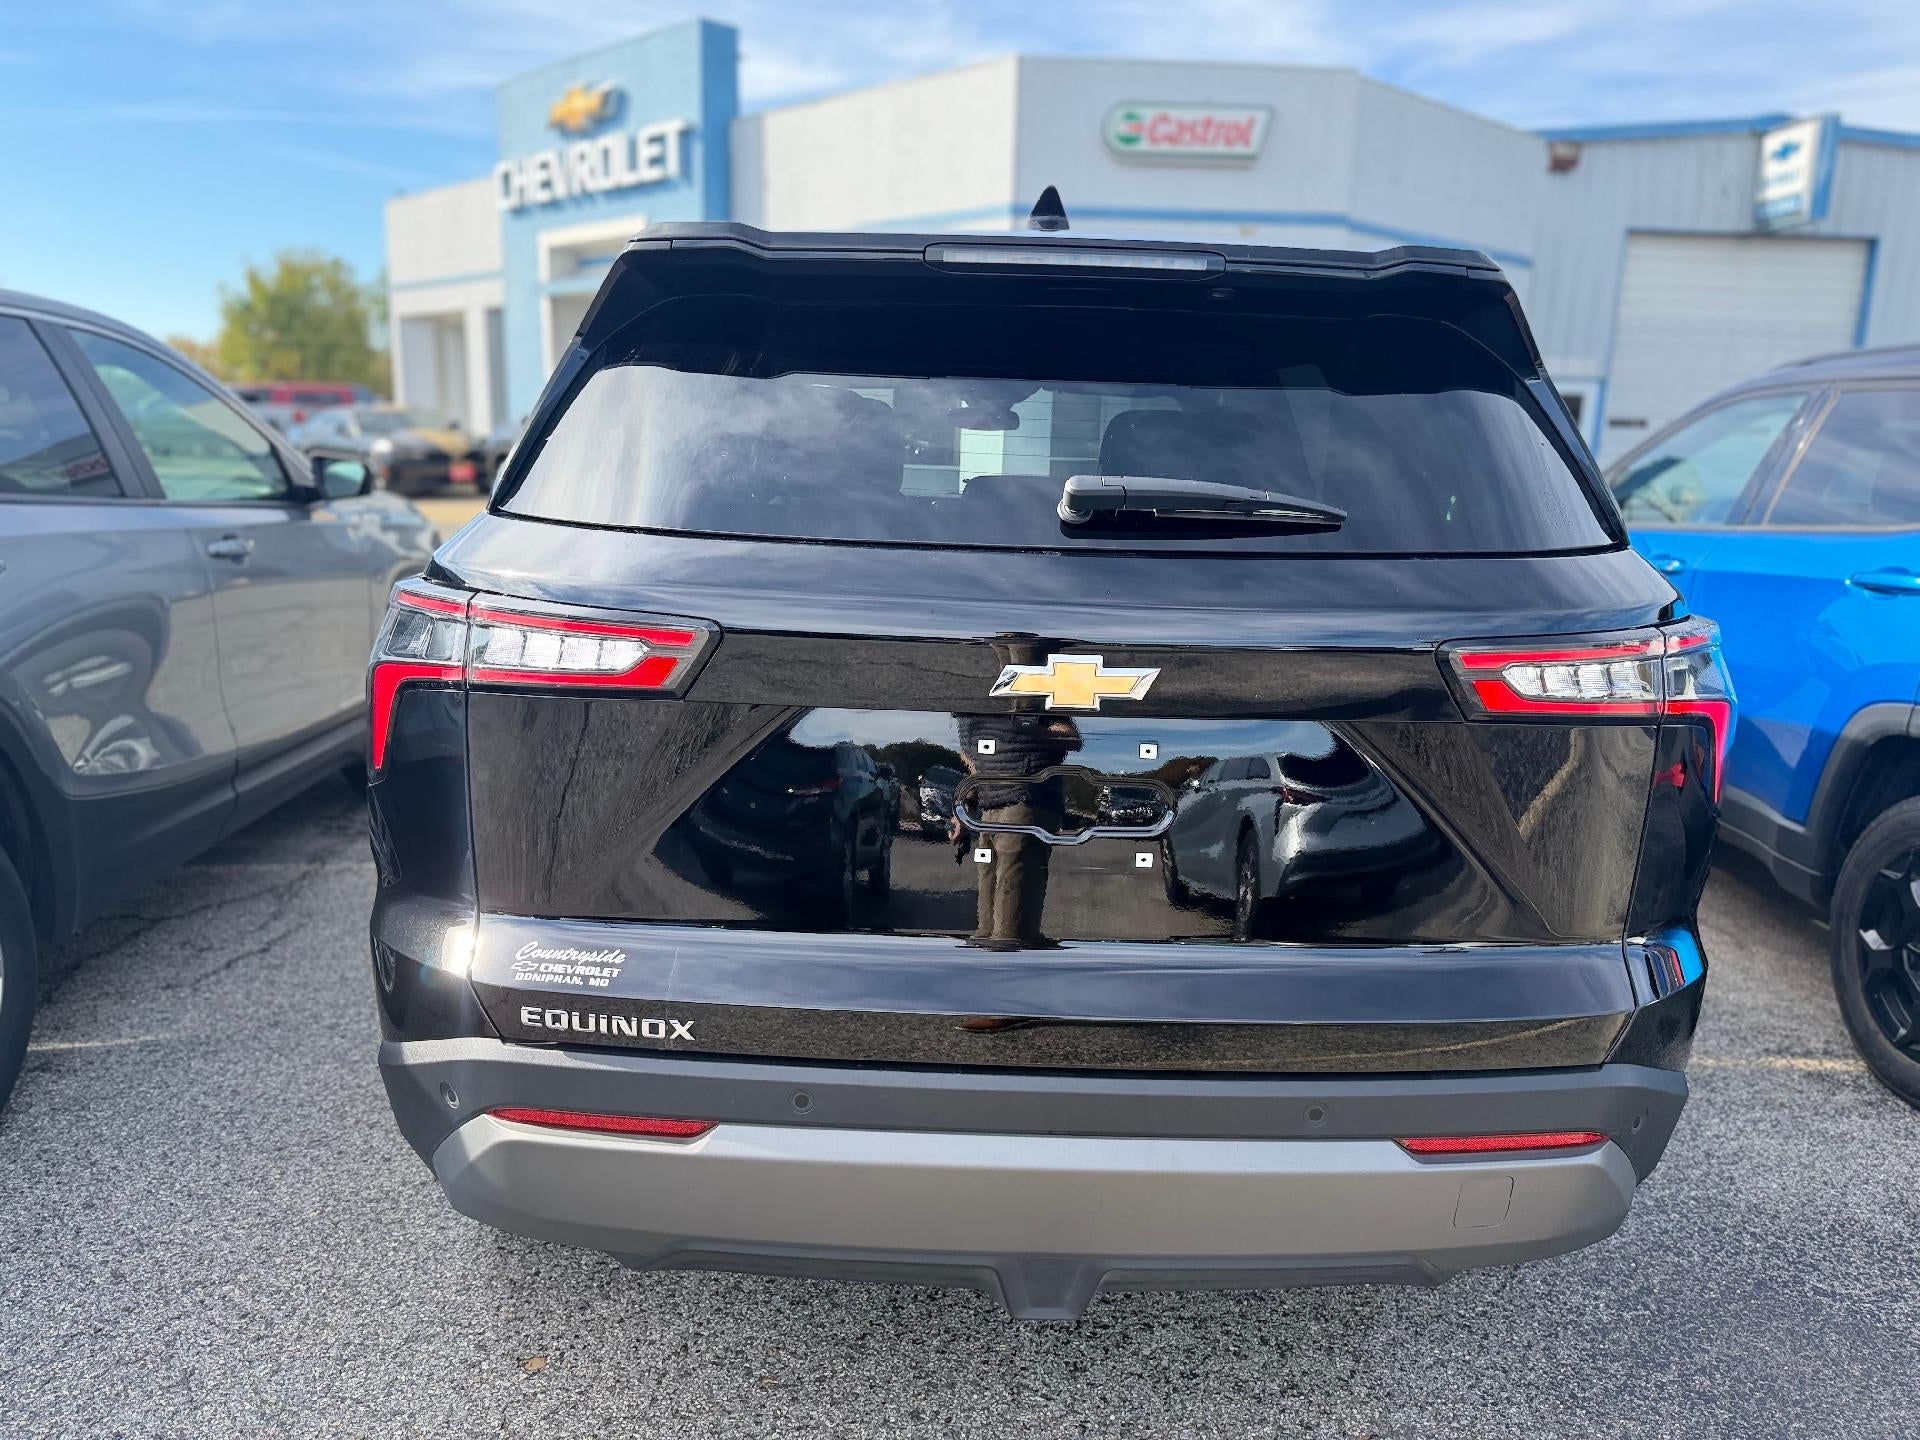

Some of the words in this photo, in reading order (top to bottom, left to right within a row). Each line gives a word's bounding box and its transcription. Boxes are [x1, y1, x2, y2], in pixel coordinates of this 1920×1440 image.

[1146, 111, 1257, 148] Castrol
[494, 118, 690, 212] CHEVROLET
[515, 940, 626, 965] Countryside
[514, 971, 584, 986] DONIPHAN,
[588, 977, 610, 987] MO
[539, 962, 622, 978] CHEVROLET
[520, 1005, 696, 1041] EQUINOX
